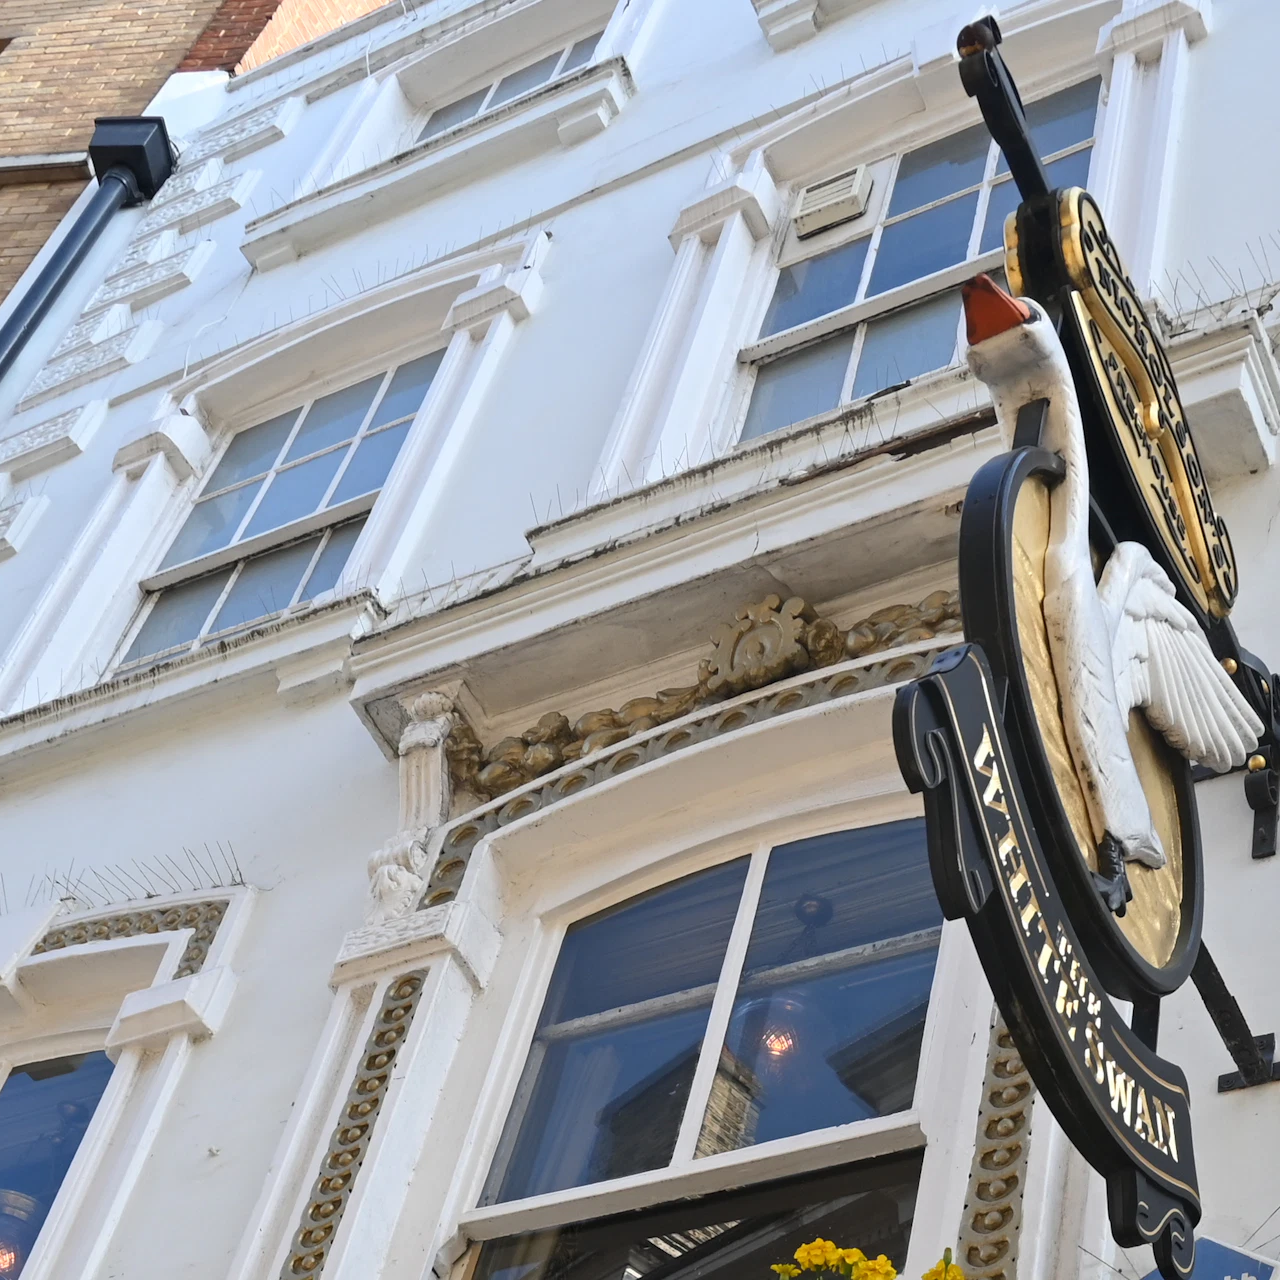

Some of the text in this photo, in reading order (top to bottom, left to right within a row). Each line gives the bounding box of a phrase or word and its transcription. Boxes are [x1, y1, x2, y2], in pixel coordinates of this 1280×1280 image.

[1095, 256, 1225, 569] NICHOLSON'S
[973, 722, 1179, 1163] WHITE SWAN
